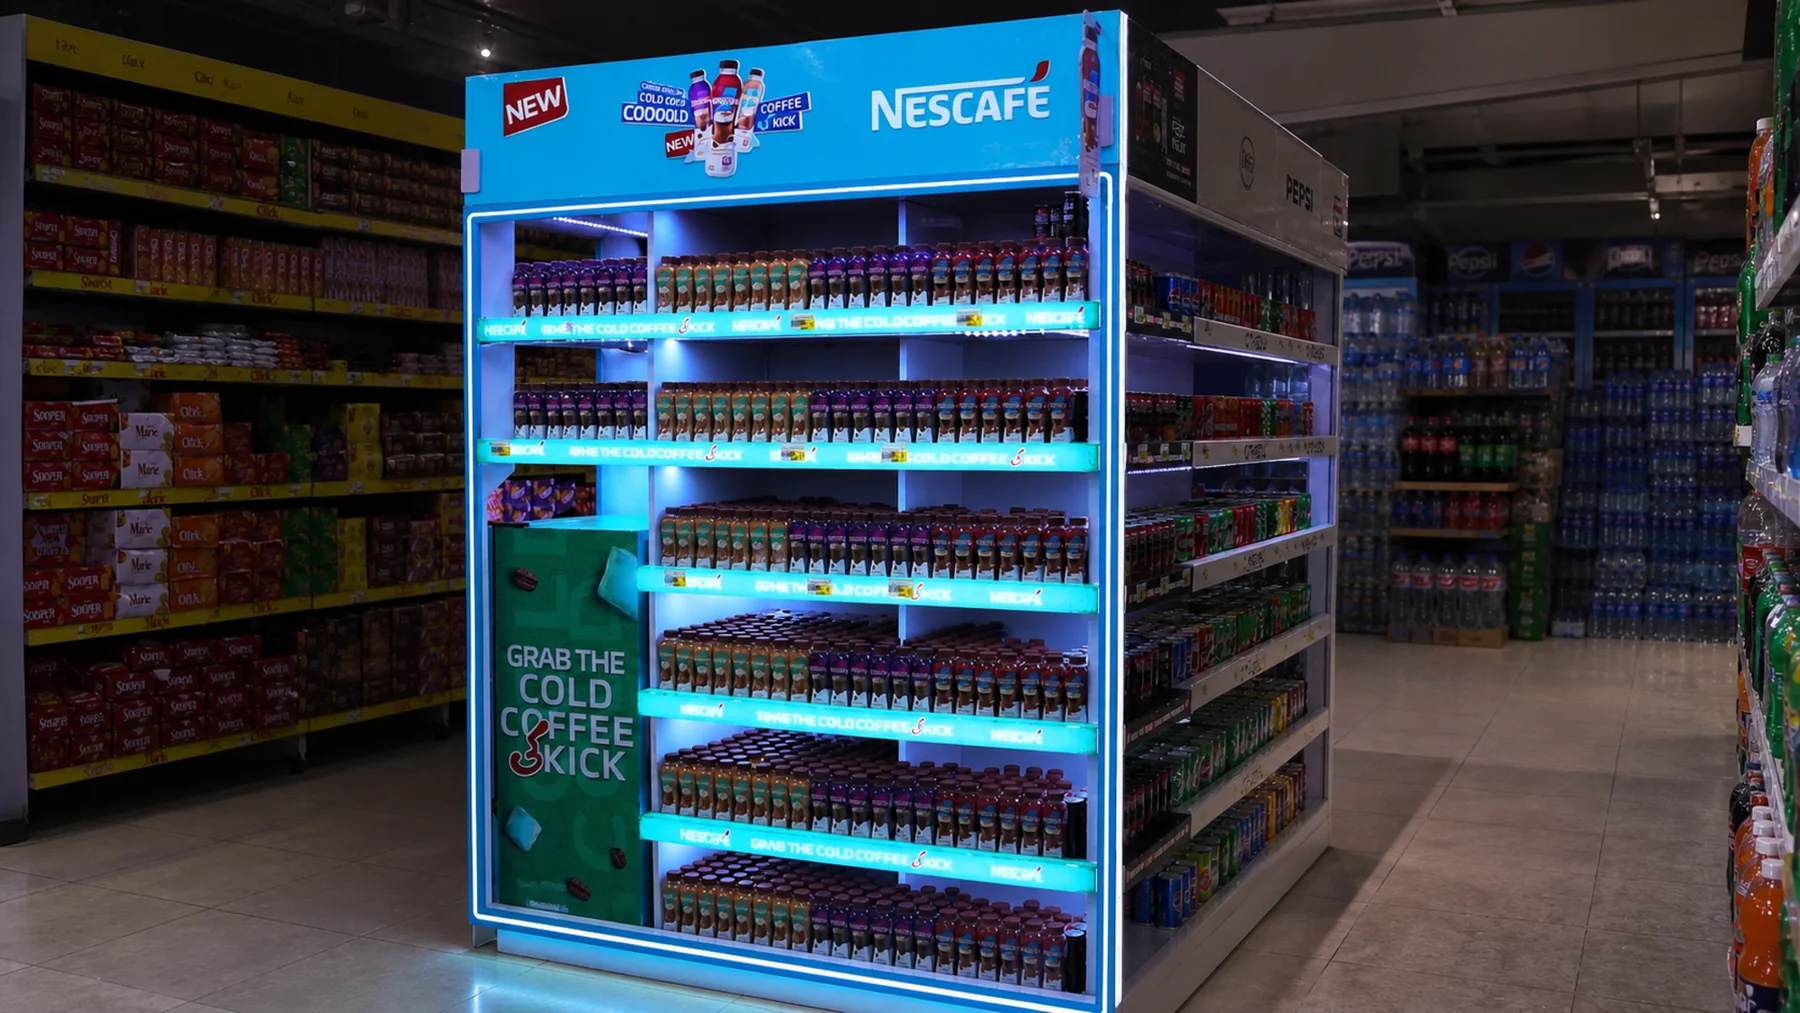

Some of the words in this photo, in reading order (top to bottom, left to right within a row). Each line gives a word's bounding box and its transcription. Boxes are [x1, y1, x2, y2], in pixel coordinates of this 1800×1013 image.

[505, 84, 562, 126] NEW
[640, 92, 664, 105] COLD
[761, 96, 802, 115] COFFEE
[623, 105, 689, 124] COOOOLD
[772, 114, 797, 129] KICK
[666, 133, 694, 153] NEW
[596, 323, 628, 335] COLD
[629, 322, 677, 335] COFFEE
[623, 447, 655, 459] COLD
[656, 447, 703, 460] COFFEE
[951, 452, 1008, 465] COFFEE
[506, 644, 572, 671] GRAB
[575, 648, 626, 675] THE
[520, 673, 613, 710] COLD
[500, 706, 634, 748] COFFEE
[792, 713, 816, 727] THE
[818, 715, 855, 730] COLD
[856, 717, 911, 734] COFFEE
[543, 743, 627, 781] KICK
[789, 842, 814, 856] THE
[817, 844, 854, 859] COLD
[855, 848, 910, 866] COFFEE
